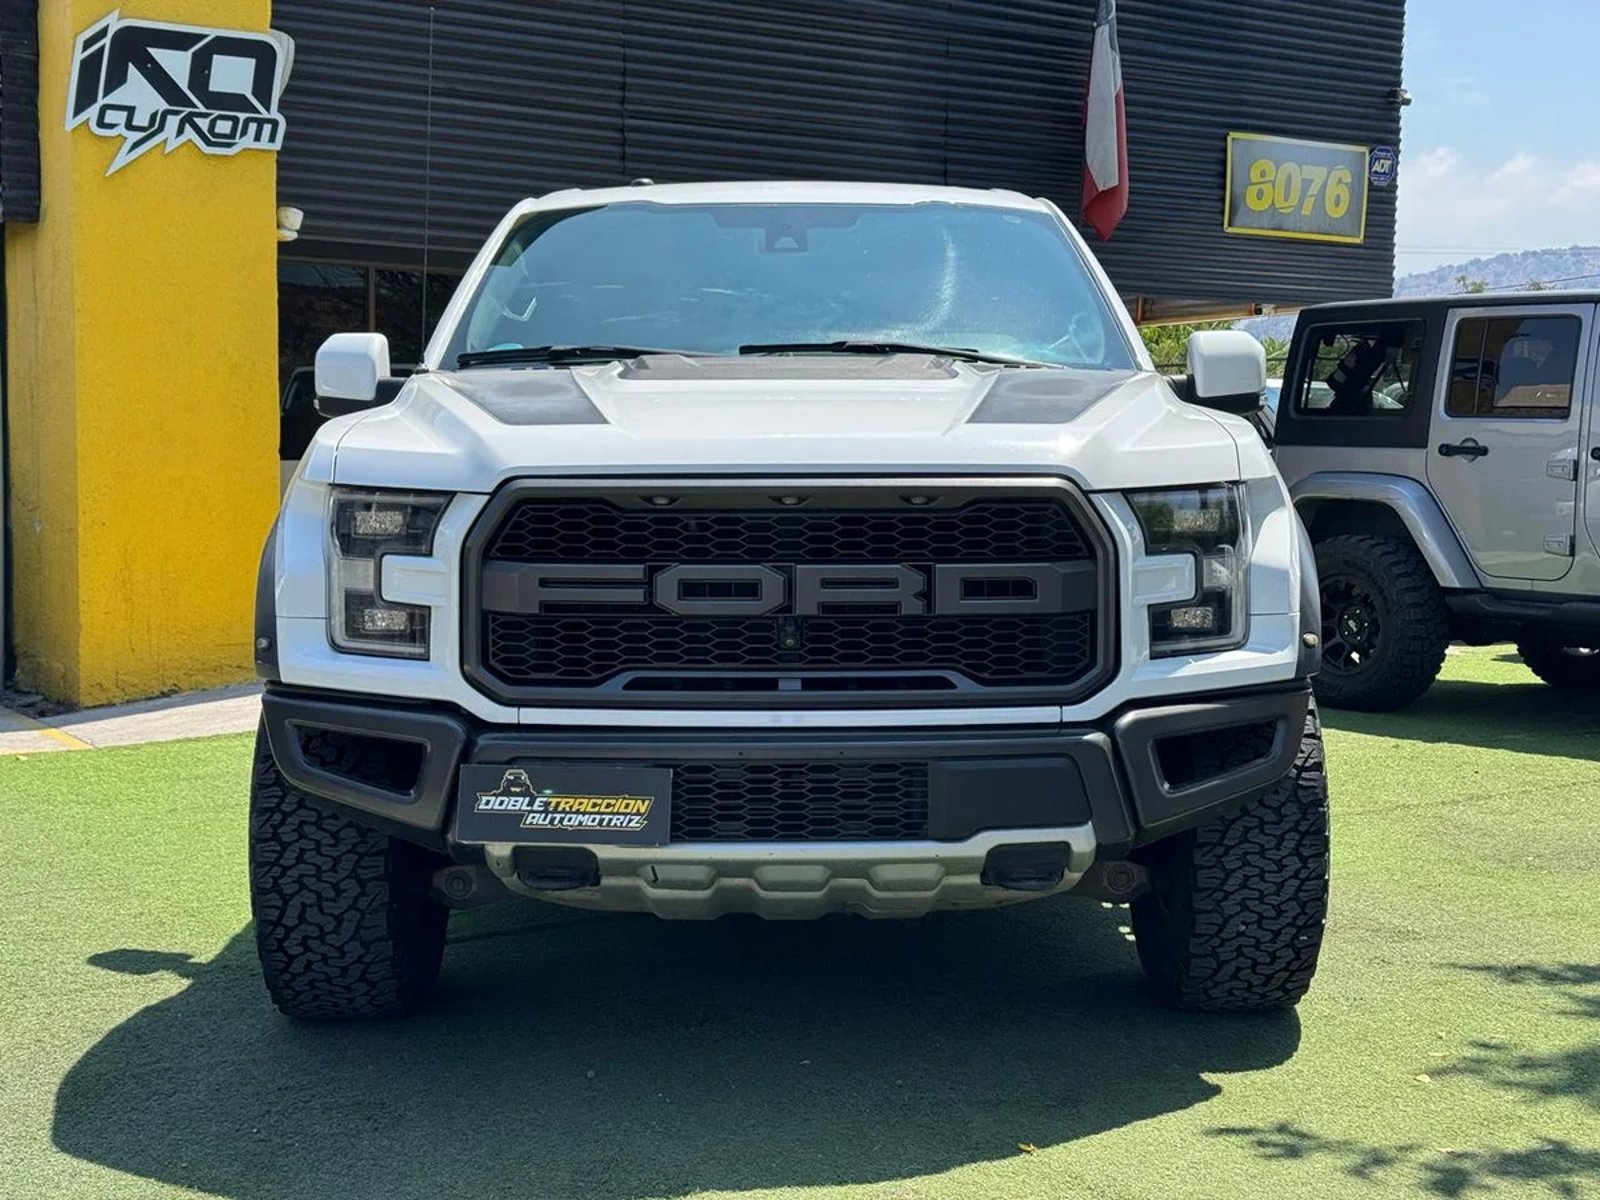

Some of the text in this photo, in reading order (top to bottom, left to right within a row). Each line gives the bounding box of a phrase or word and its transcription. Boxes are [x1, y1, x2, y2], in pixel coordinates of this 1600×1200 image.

[1371, 159, 1392, 174] ADT
[1245, 158, 1353, 219] 8076
[510, 562, 1064, 617] FORD
[525, 812, 643, 828] AUTOMOTRIZ
